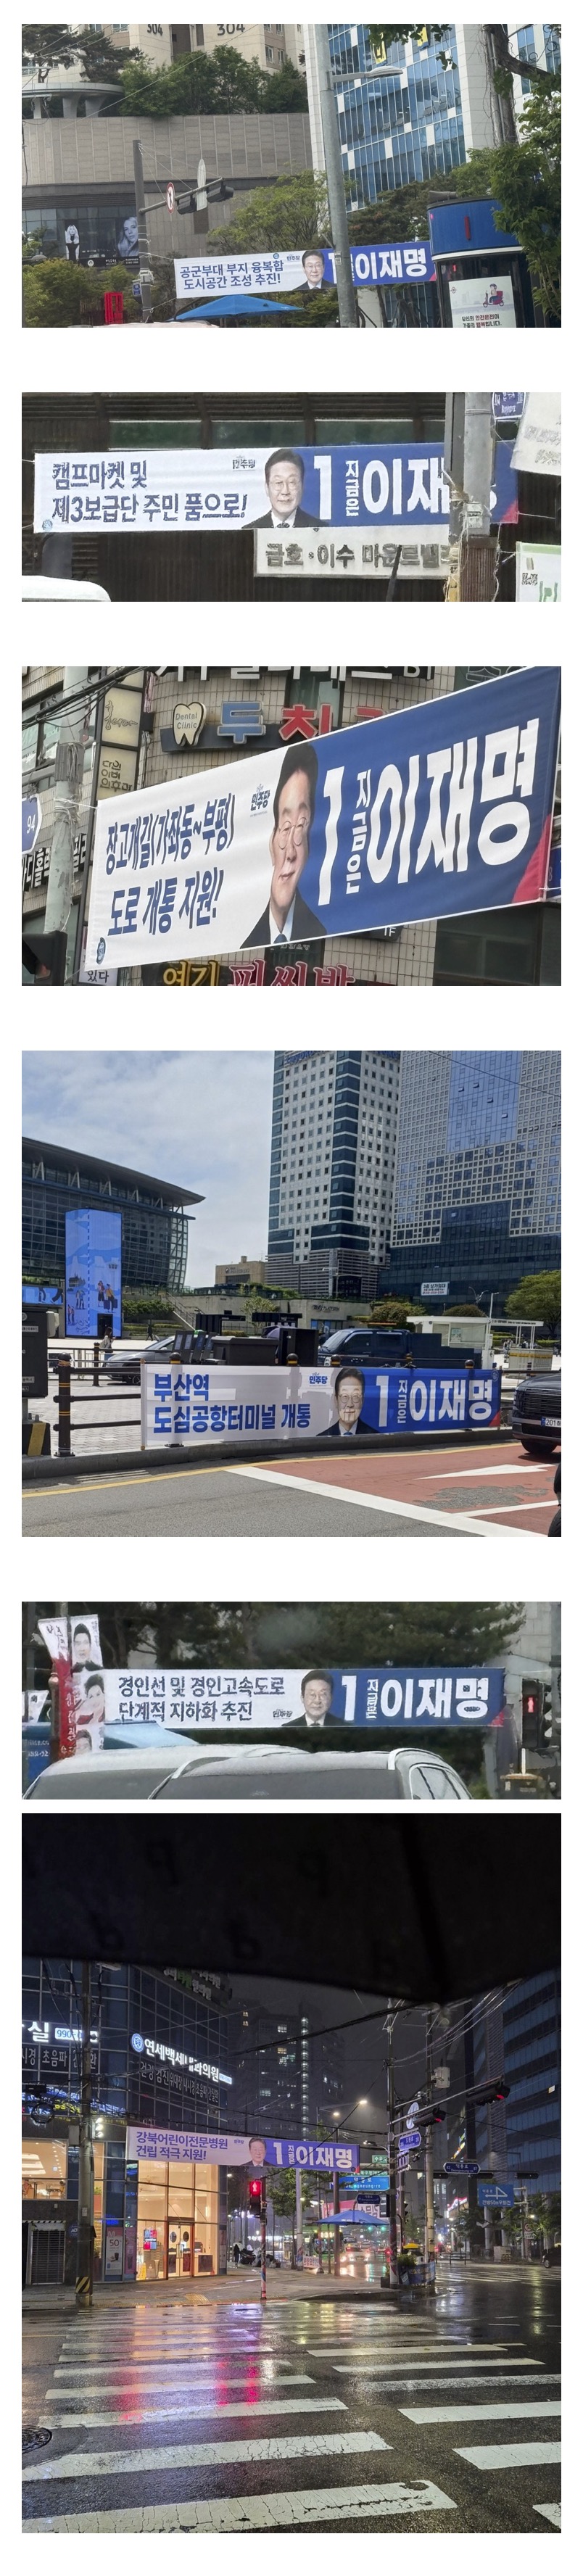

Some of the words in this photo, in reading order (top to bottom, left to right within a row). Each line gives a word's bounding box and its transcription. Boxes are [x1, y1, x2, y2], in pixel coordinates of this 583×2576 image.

[180, 264, 223, 278] 공군부대
[227, 262, 248, 275] 부지
[252, 260, 284, 273] 융복합
[355, 249, 427, 280] 이재명
[183, 276, 227, 289] 도시공간
[231, 275, 252, 286] 조성
[255, 273, 281, 286] 추진!
[52, 460, 125, 490] 캠프마켓
[131, 460, 147, 489] 및
[314, 455, 331, 520] 1
[346, 460, 359, 516] 지금은
[52, 493, 139, 523] 제3보급단
[143, 493, 178, 522] 주민
[184, 493, 247, 521] 품으로!
[175, 712, 197, 721] Dental
[251, 790, 270, 811] 민주당
[318, 766, 344, 906] 1
[346, 769, 371, 894] 지금은
[367, 718, 539, 884] 이재명
[27, 814, 36, 834] 94
[106, 793, 236, 875] 장고개길(가좌동~부평)
[108, 887, 141, 936] 도로
[143, 877, 178, 935] 개통
[179, 867, 224, 929] 지원!
[88, 970, 109, 983] 있다
[163, 960, 221, 986] 여기
[154, 1374, 209, 1402] 부산역
[309, 1375, 328, 1384] 민주당
[376, 1375, 389, 1427] 1
[397, 1380, 408, 1424] 지금은
[409, 1379, 492, 1422] 이재명
[154, 1404, 276, 1433] 도심공항터미널
[281, 1404, 310, 1428] 개통
[119, 1676, 165, 1697] 경인선
[170, 1676, 185, 1697] 및
[191, 1676, 285, 1697] 경인고속도로
[342, 1676, 357, 1720] 1
[381, 1678, 489, 1718] 이재명
[119, 1702, 165, 1722] 단계적
[170, 1701, 218, 1722] 지하화
[221, 1701, 252, 1721] 추진
[22, 2021, 49, 2042] 실
[42, 2050, 67, 2066] 초음파
[144, 2039, 219, 2082] 연세백세내과의원
[156, 2068, 169, 2085] 검진
[136, 2132, 228, 2149] 강북어린이전문병원
[136, 2145, 157, 2158] 건립
[160, 2147, 181, 2159] 적극
[183, 2148, 206, 2161] 지원!
[273, 2142, 283, 2165] 1
[296, 2146, 352, 2168] 이재명
